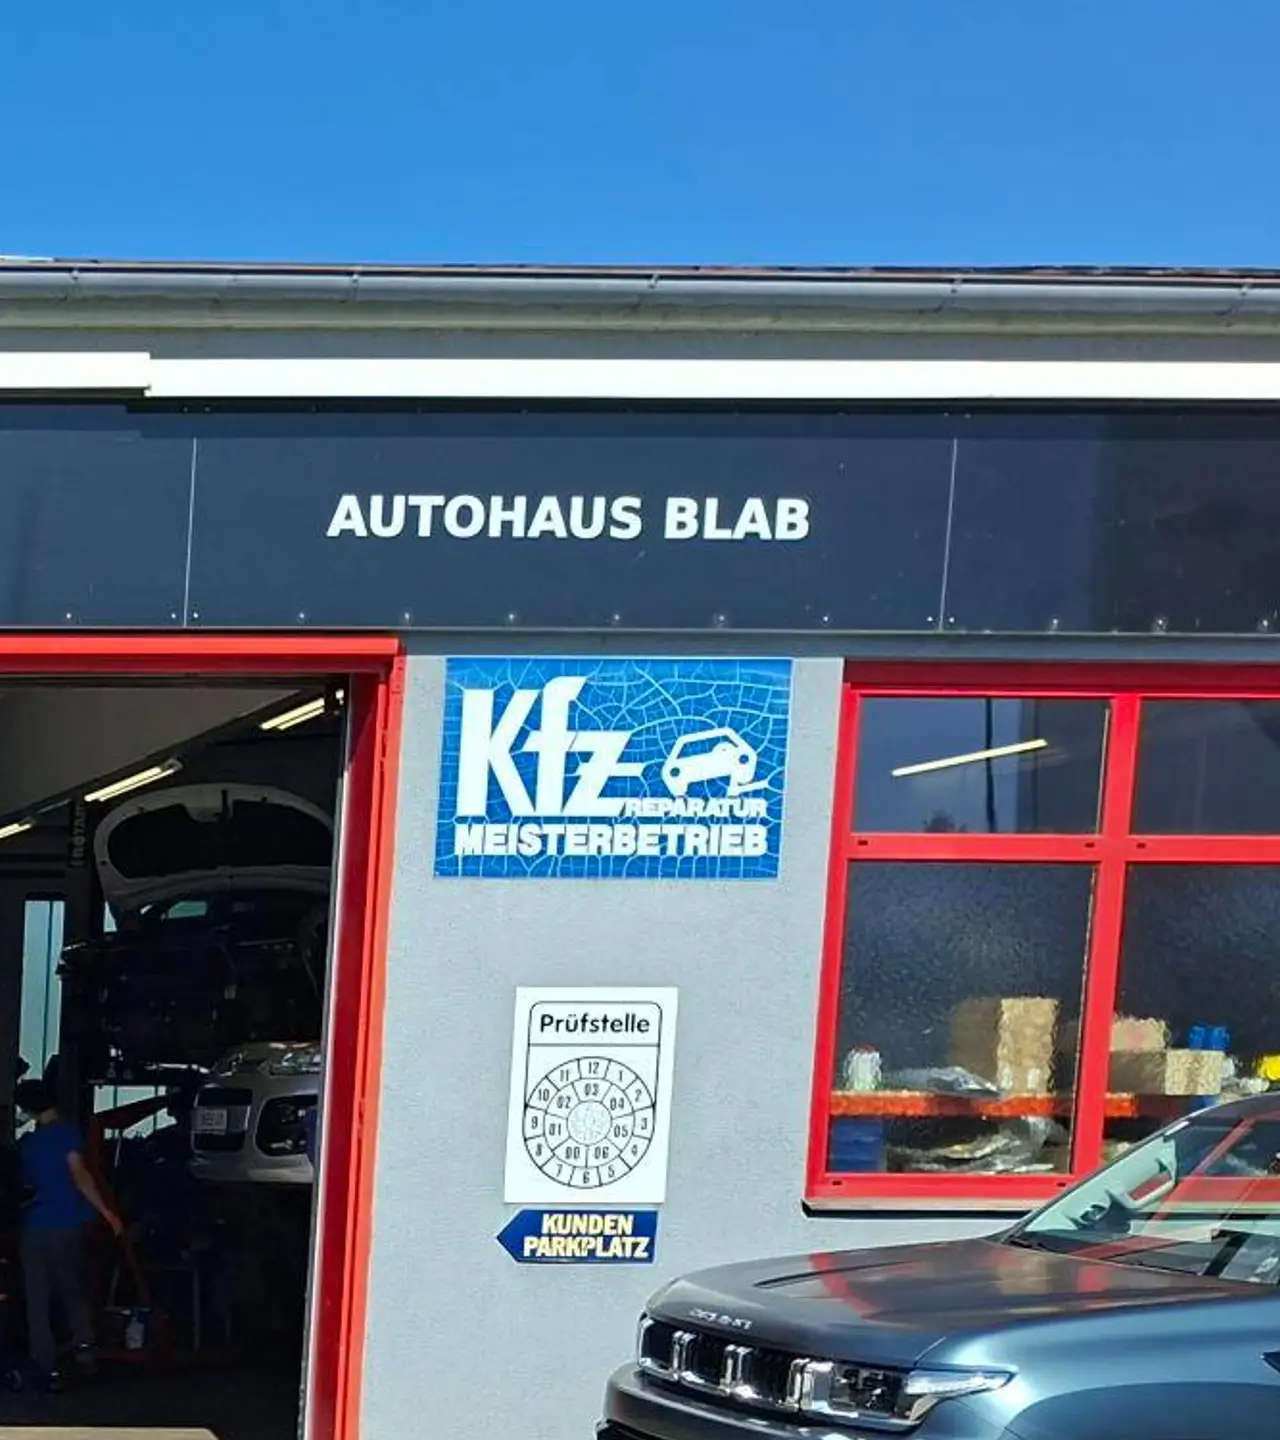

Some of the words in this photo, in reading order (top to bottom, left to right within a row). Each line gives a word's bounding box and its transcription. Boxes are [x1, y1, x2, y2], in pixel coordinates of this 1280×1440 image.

[327, 494, 642, 540] AUTOHAUS
[664, 497, 809, 541] BLAB
[456, 676, 643, 817] Kfz
[625, 799, 768, 817] REPARATUR
[454, 824, 768, 856] MEISTERBETRIEB
[539, 1014, 650, 1035] Prüfstelle
[541, 1213, 634, 1235] KUNDEN
[523, 1237, 649, 1258] PARKPLATZ
